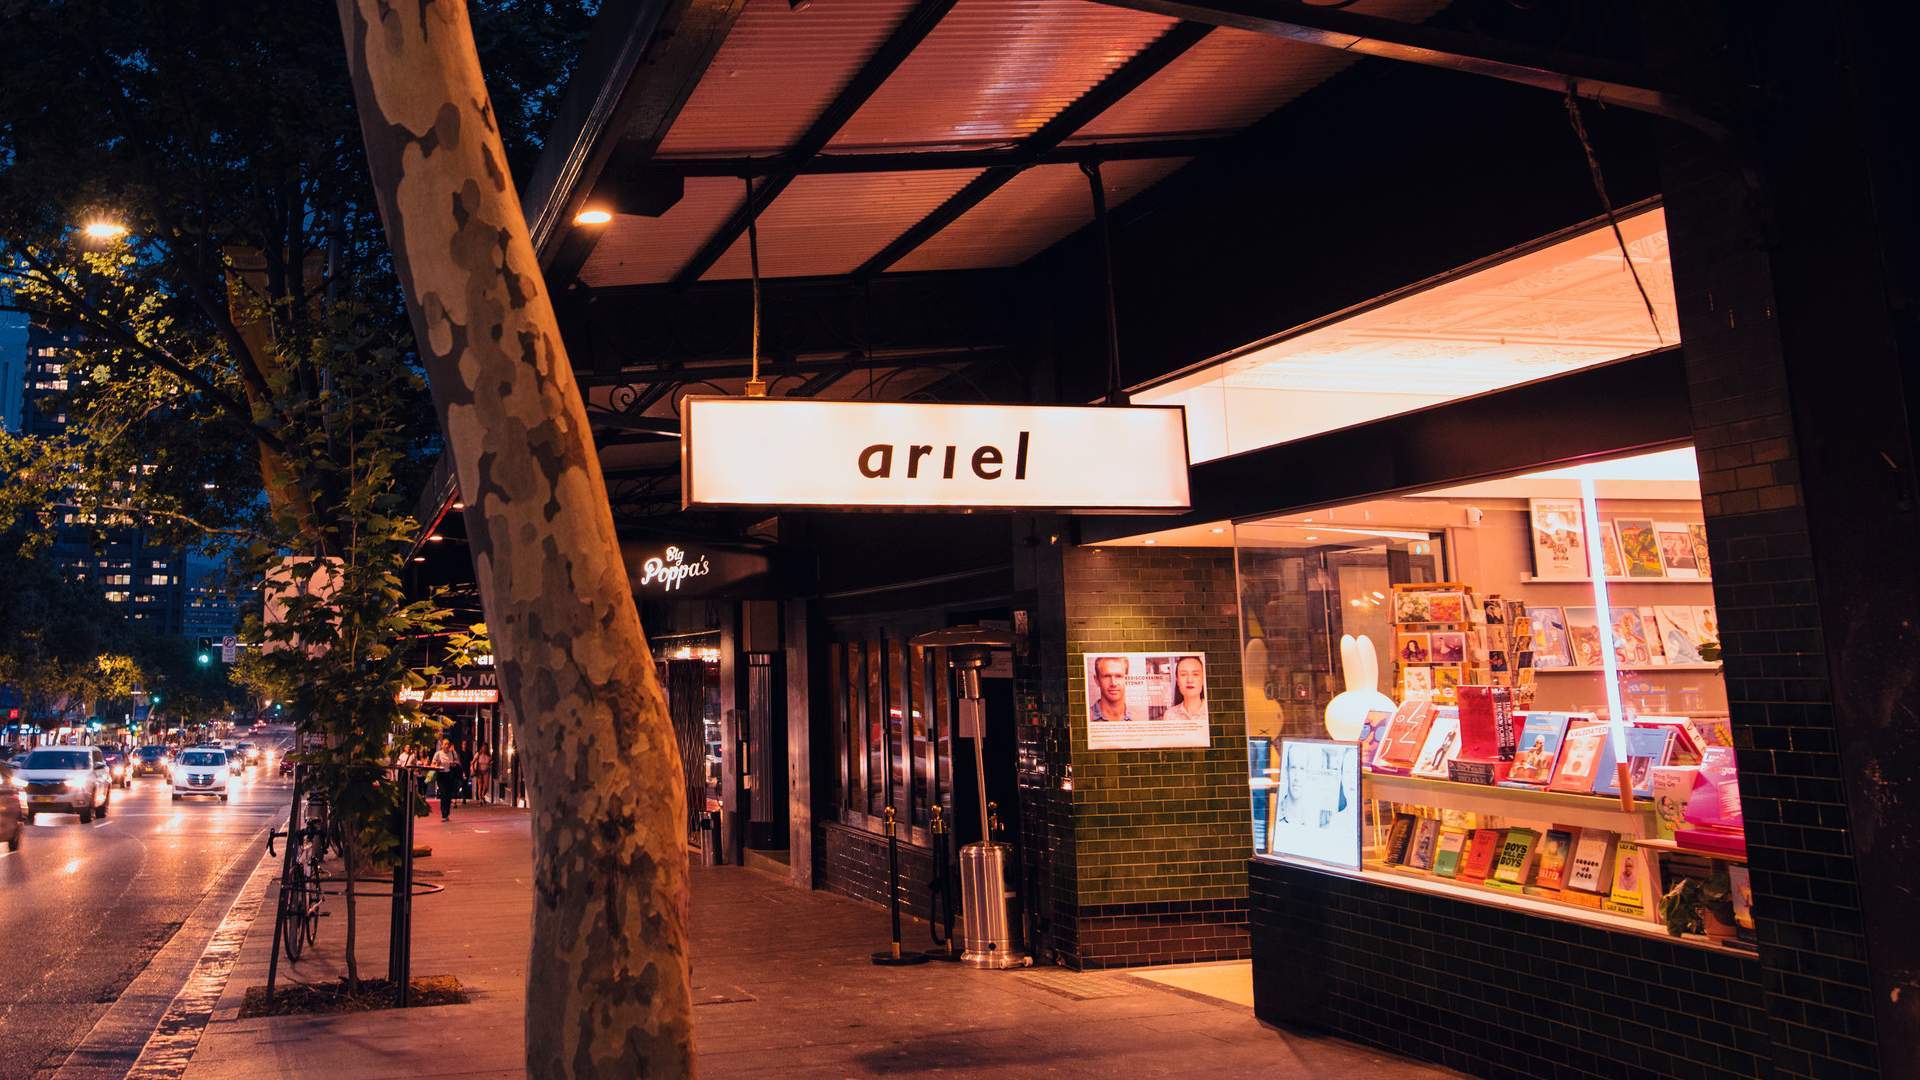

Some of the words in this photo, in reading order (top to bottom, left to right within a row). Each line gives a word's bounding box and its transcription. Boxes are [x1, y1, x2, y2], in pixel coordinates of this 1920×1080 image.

[858, 431, 1030, 480] ariel
[665, 546, 685, 566] Big
[641, 555, 709, 592] Poppa's
[1505, 842, 1527, 853] BOYS
[1500, 857, 1523, 868] BOYS
